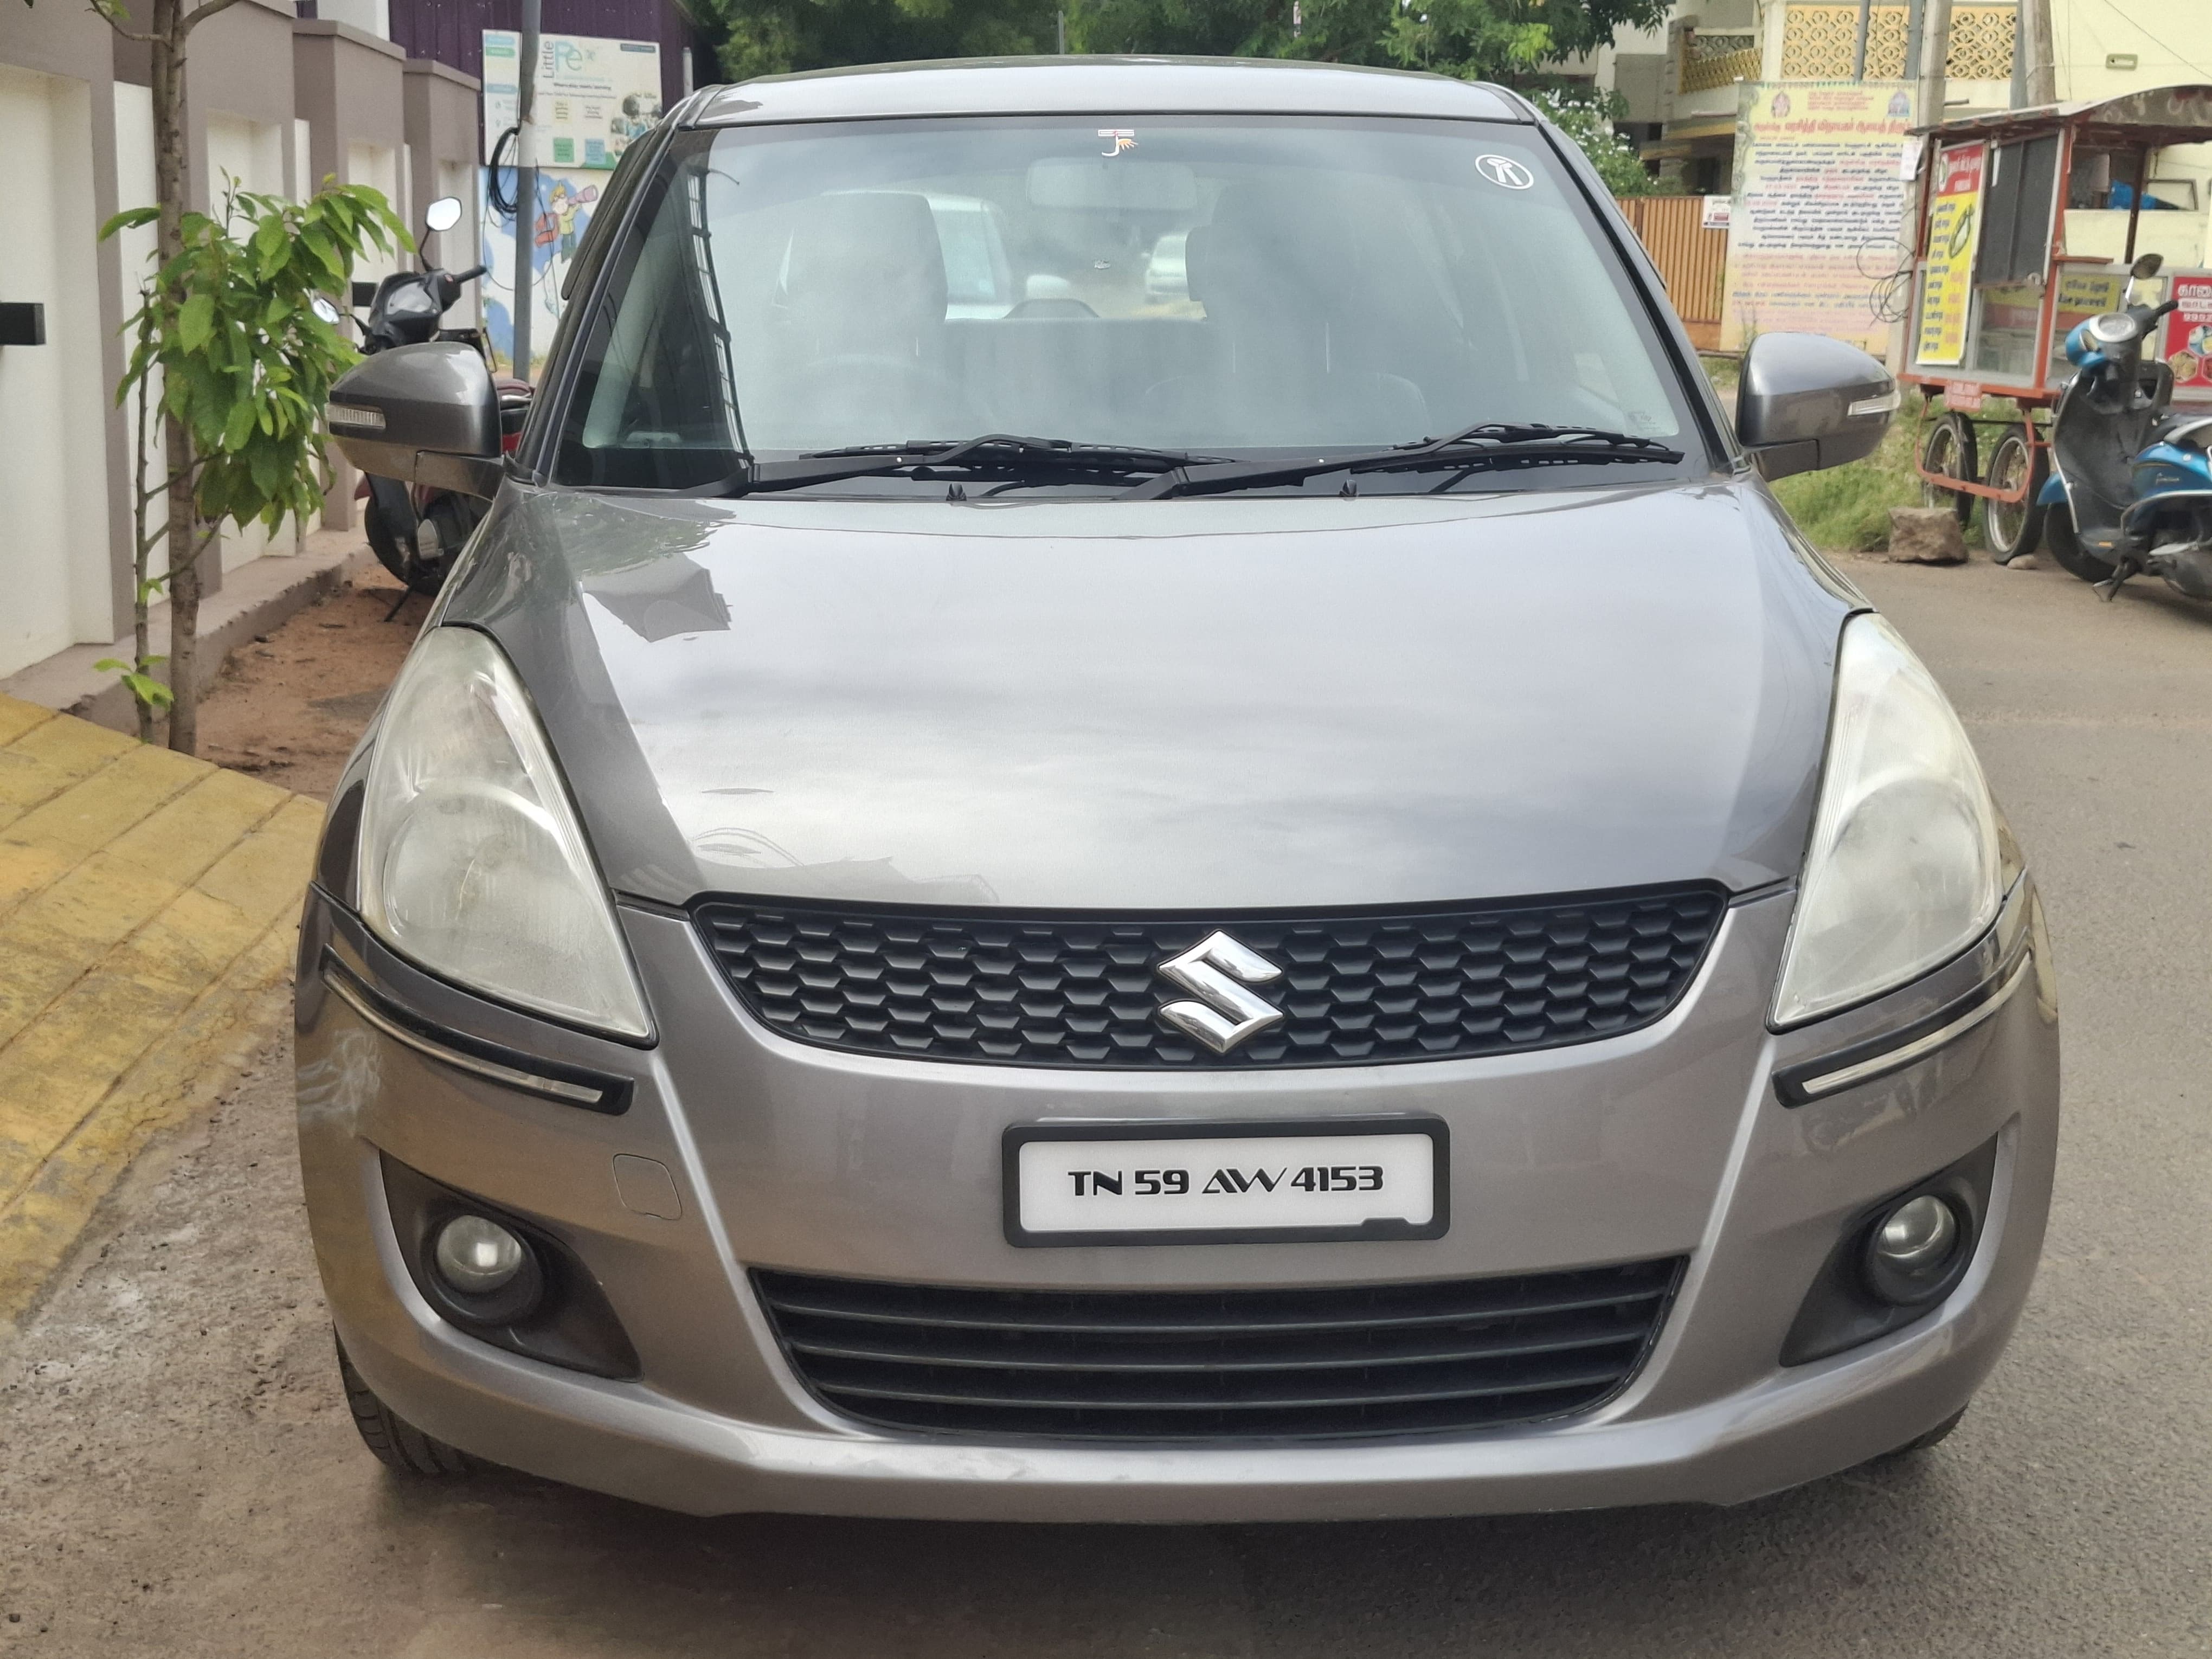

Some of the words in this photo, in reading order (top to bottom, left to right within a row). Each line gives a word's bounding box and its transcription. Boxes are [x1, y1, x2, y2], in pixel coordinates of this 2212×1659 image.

[542, 41, 554, 78] Little
[1068, 1169, 1122, 1196] TN
[1134, 1169, 1190, 1195] 59
[1201, 1167, 1288, 1194] AW
[1290, 1166, 1384, 1192] 4153
